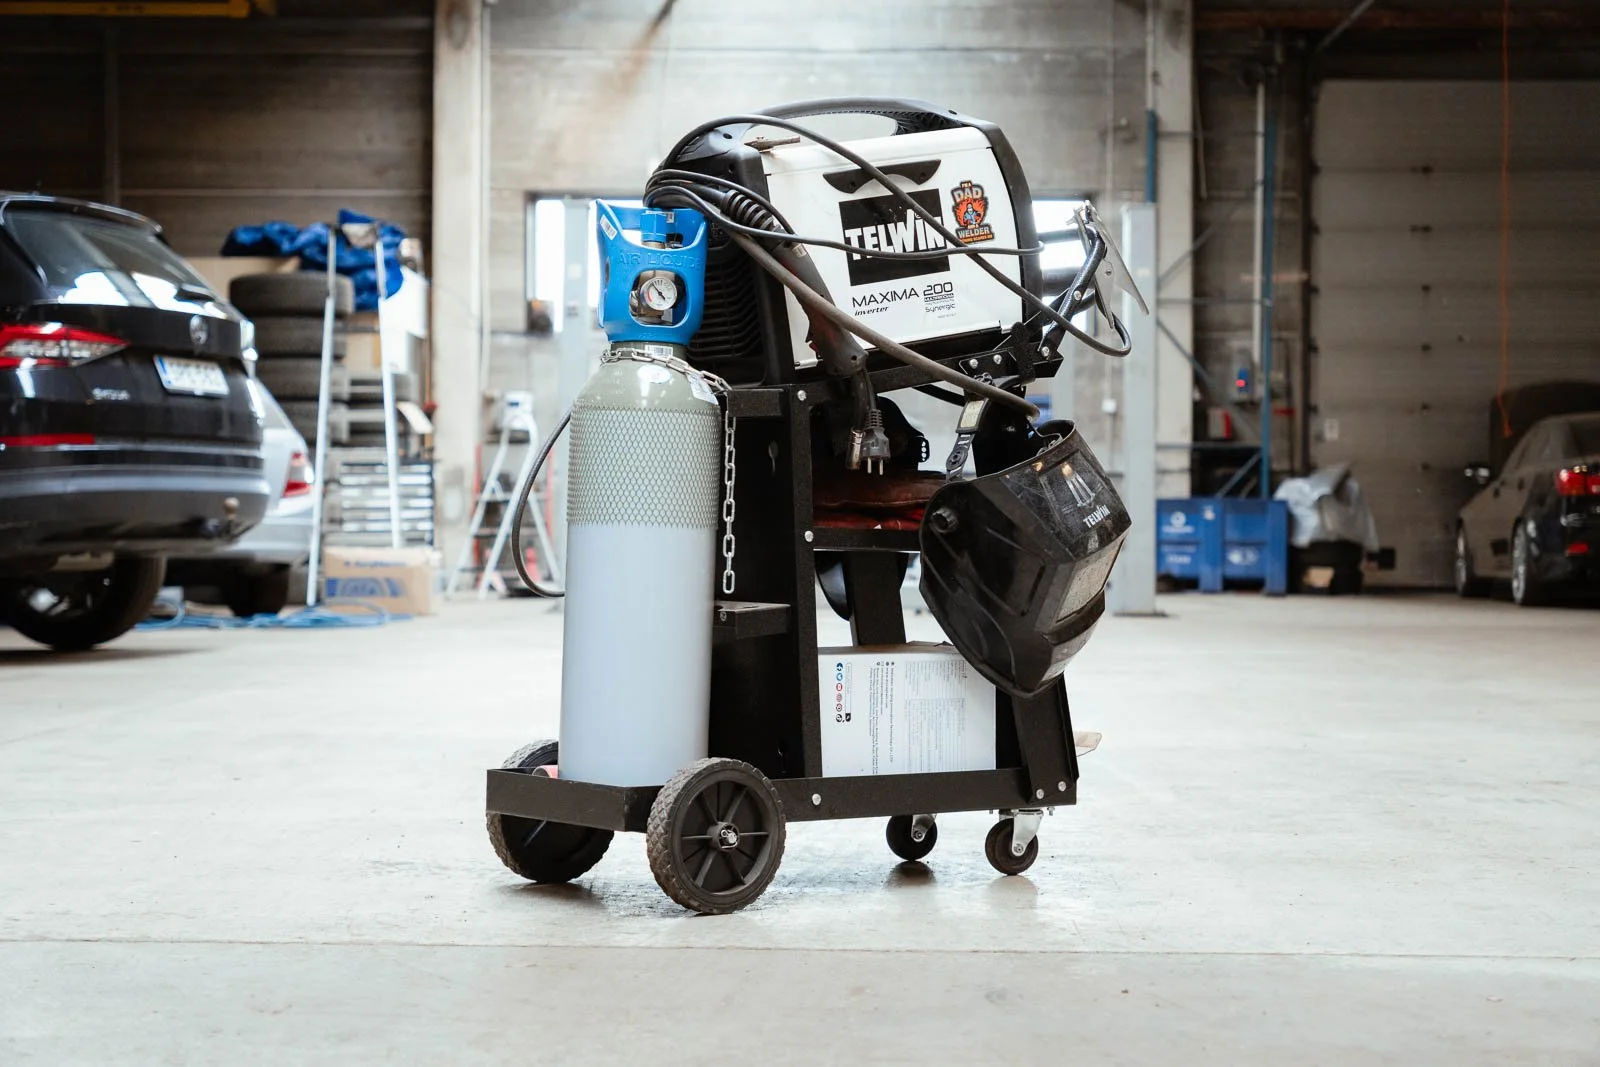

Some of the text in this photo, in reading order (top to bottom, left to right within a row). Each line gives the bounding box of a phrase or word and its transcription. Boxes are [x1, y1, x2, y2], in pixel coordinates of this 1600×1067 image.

[953, 187, 982, 203] DAD
[844, 208, 946, 261] TELWIN
[957, 226, 991, 239] WELDER
[618, 252, 641, 265] AIR
[852, 287, 919, 308] MAXIMA
[923, 281, 953, 297] 200
[855, 305, 889, 317] inverter
[925, 303, 956, 313] Synergic
[1083, 504, 1110, 528] TELWIN
